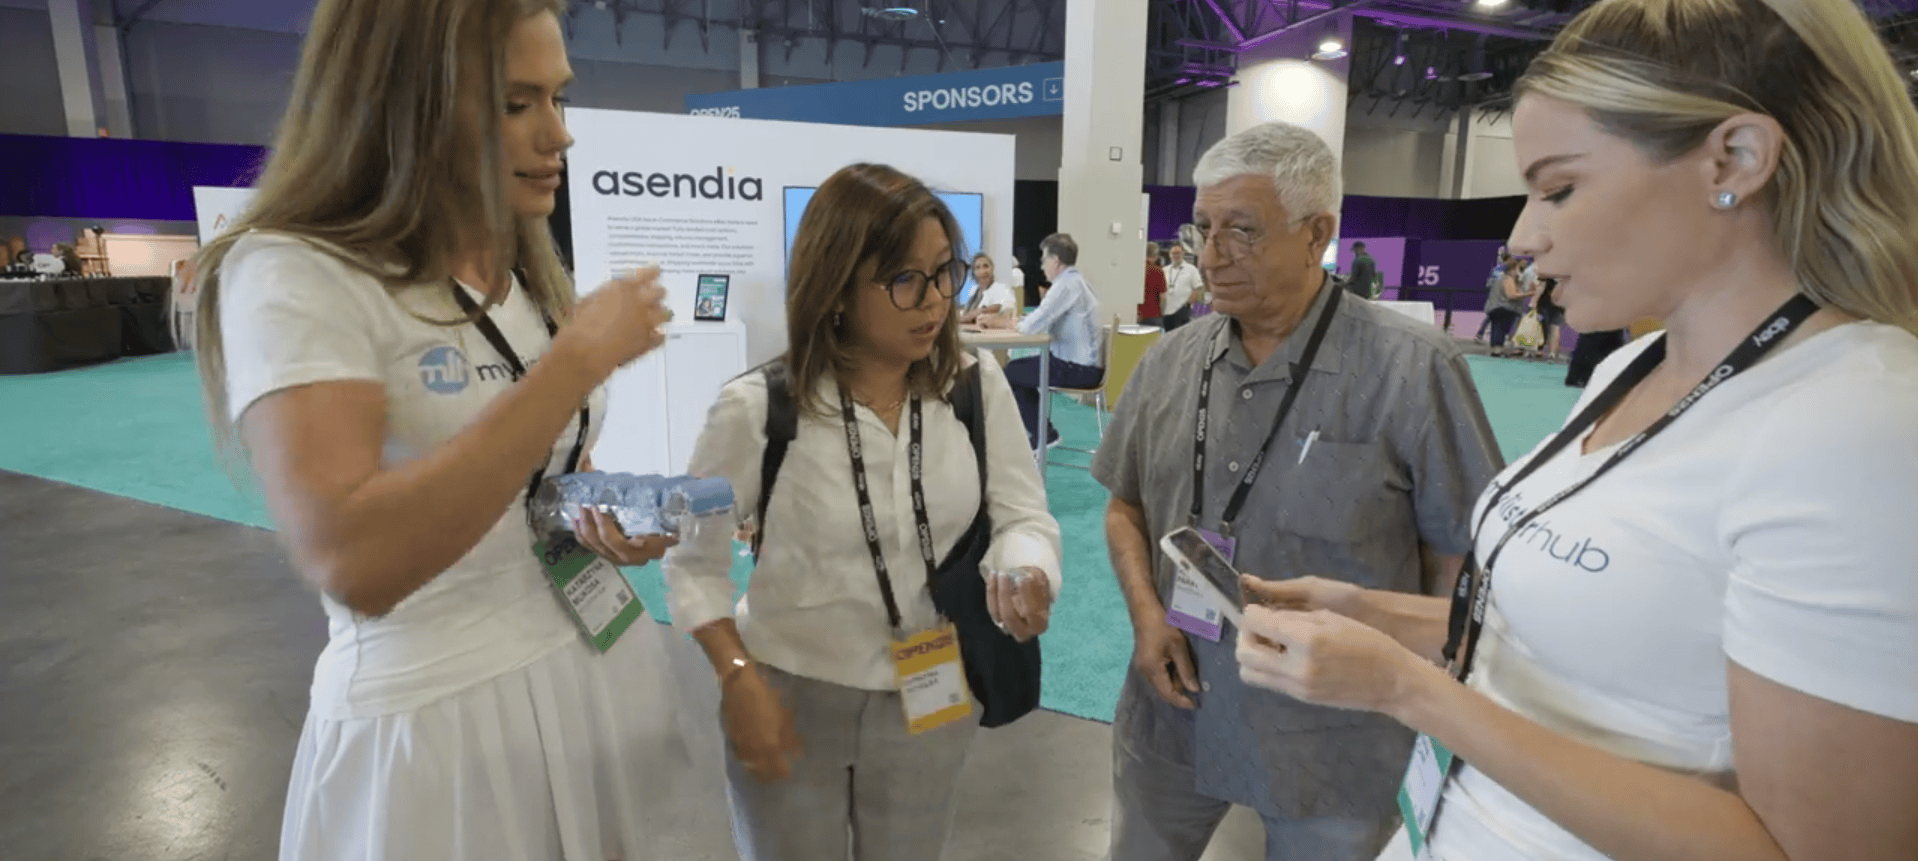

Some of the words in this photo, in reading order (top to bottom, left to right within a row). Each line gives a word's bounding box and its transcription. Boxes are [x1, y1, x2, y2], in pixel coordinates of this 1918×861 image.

[903, 81, 1034, 113] SPONSORS
[592, 166, 763, 201] asendia
[1752, 316, 1790, 348] ebay
